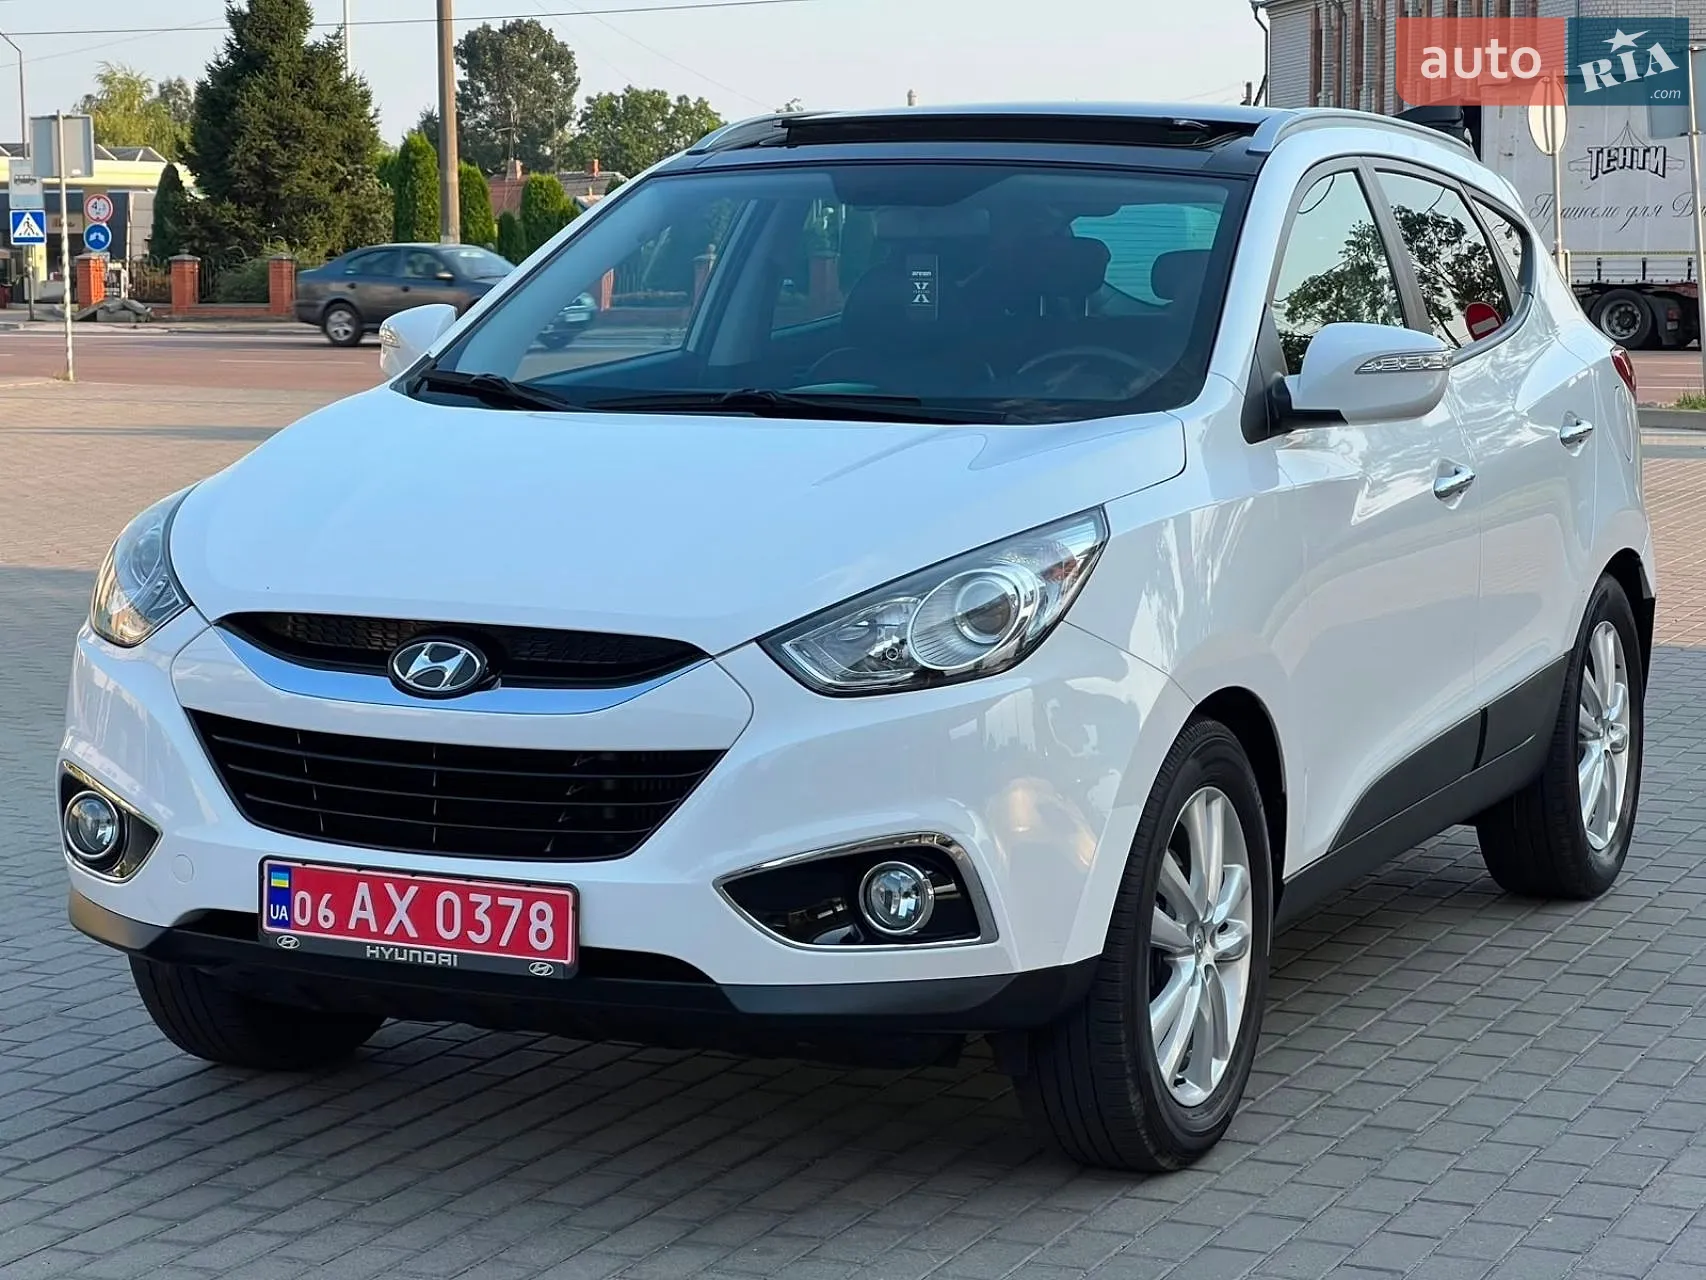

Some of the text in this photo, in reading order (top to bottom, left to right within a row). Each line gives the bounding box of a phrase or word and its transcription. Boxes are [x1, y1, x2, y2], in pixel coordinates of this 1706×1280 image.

[1587, 145, 1667, 181] ТЕНТИ
[270, 903, 289, 922] UA
[294, 881, 554, 952] 06 AX 0378
[365, 945, 459, 967] HYUNDAI
